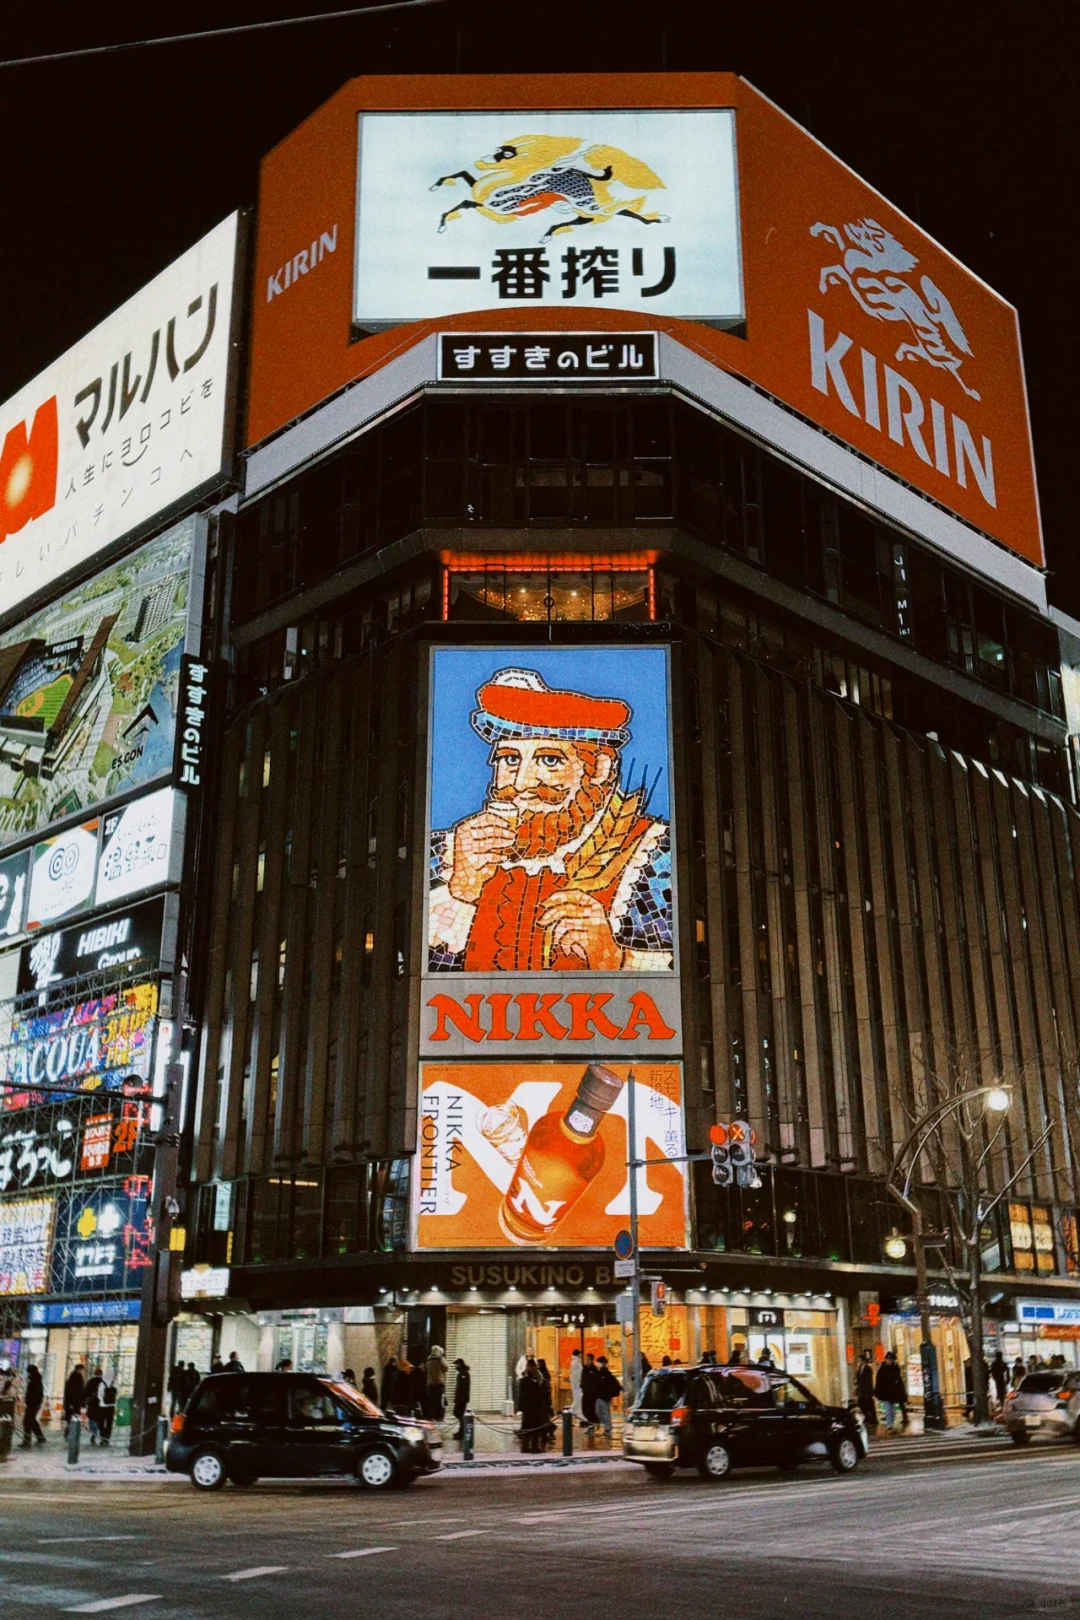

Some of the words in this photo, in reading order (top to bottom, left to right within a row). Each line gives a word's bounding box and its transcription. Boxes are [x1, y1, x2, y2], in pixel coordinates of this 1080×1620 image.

[266, 223, 338, 303] KIRIN
[427, 245, 677, 299] 一番搾り
[73, 282, 218, 450] マルハン
[452, 344, 644, 370] すすきのビル
[65, 377, 214, 499] 人生にヨロコビを
[807, 307, 998, 510] KIRIN
[180, 663, 208, 785] すすきのビル
[77, 918, 130, 957] HIBIKI
[426, 990, 677, 1043] NIKKA
[419, 1095, 440, 1214] FRONTIER
[445, 1095, 463, 1172] NIKKA
[451, 1264, 585, 1286] SUSUKINO
